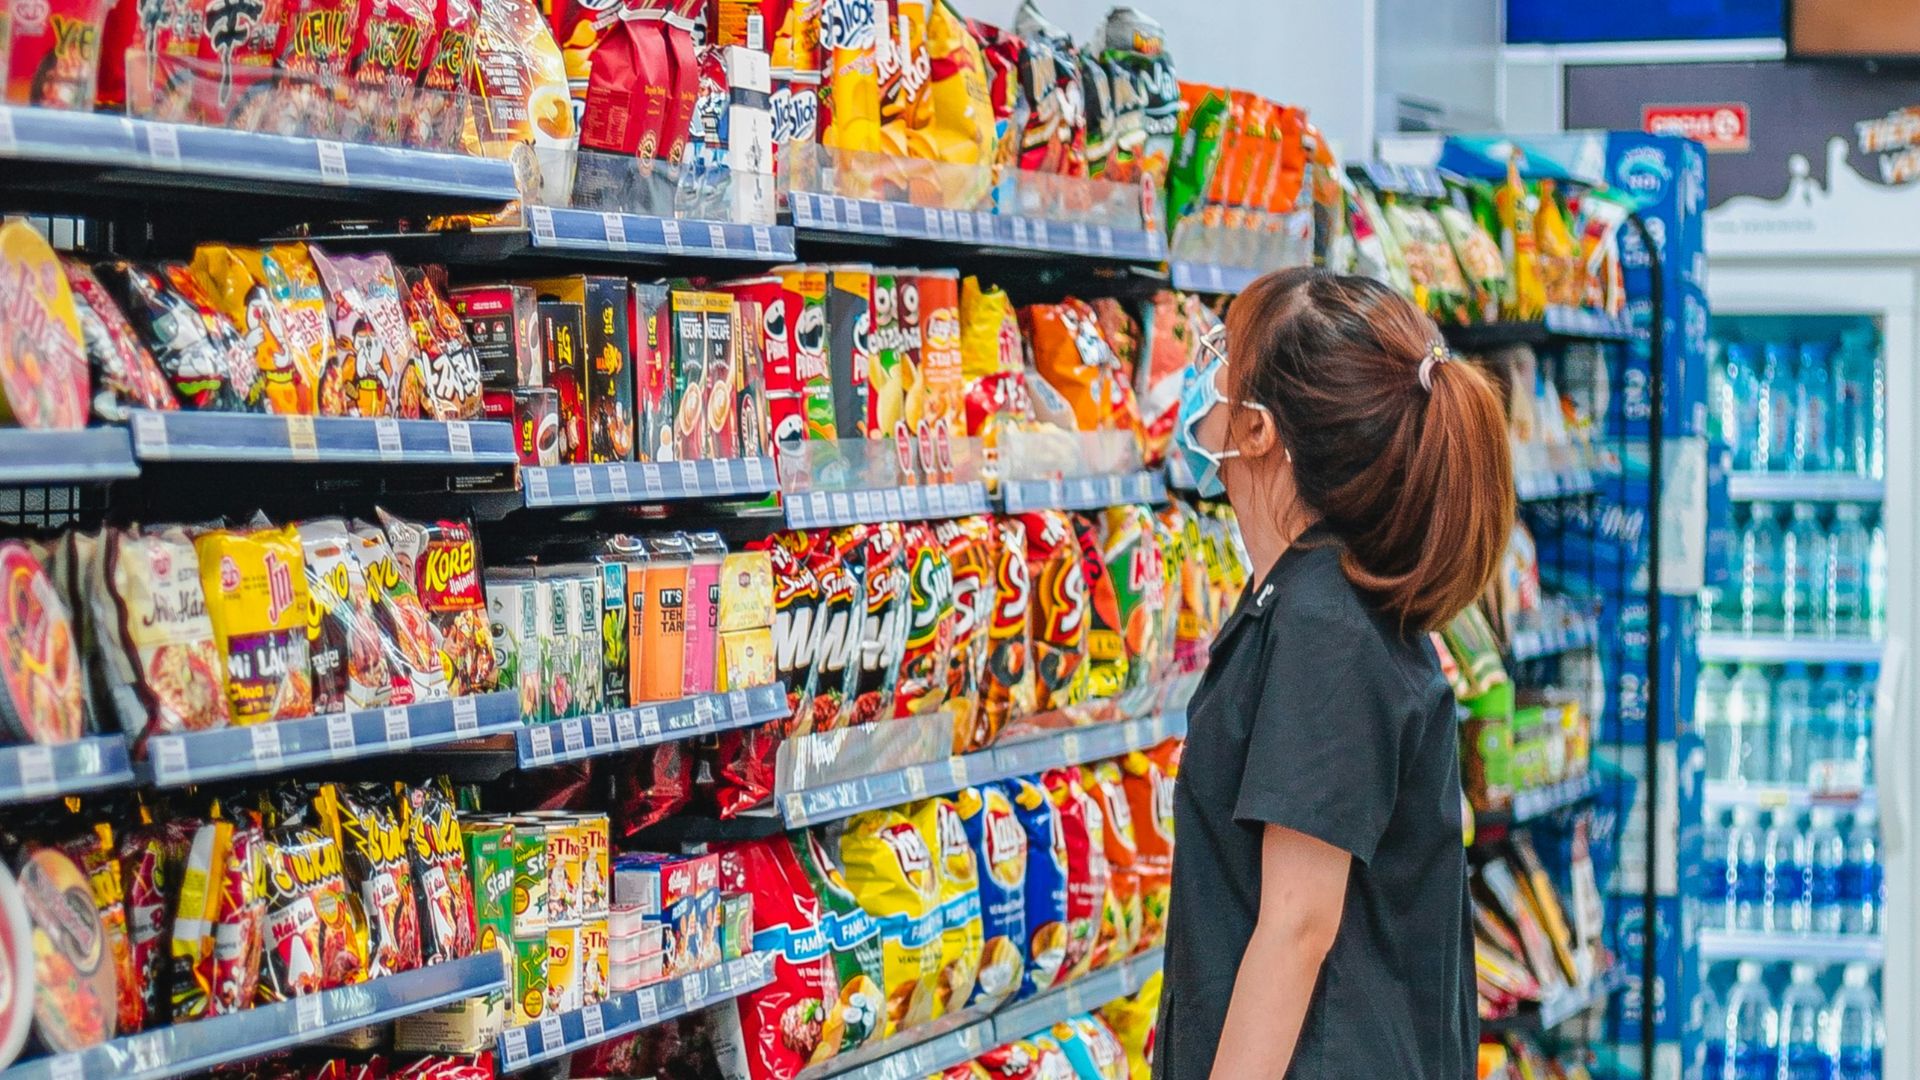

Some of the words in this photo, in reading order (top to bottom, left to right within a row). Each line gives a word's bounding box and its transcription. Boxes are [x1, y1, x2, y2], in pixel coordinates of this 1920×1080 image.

[661, 589, 683, 604] IT'S
[661, 610, 683, 621] TEH
[486, 869, 514, 902] Star
